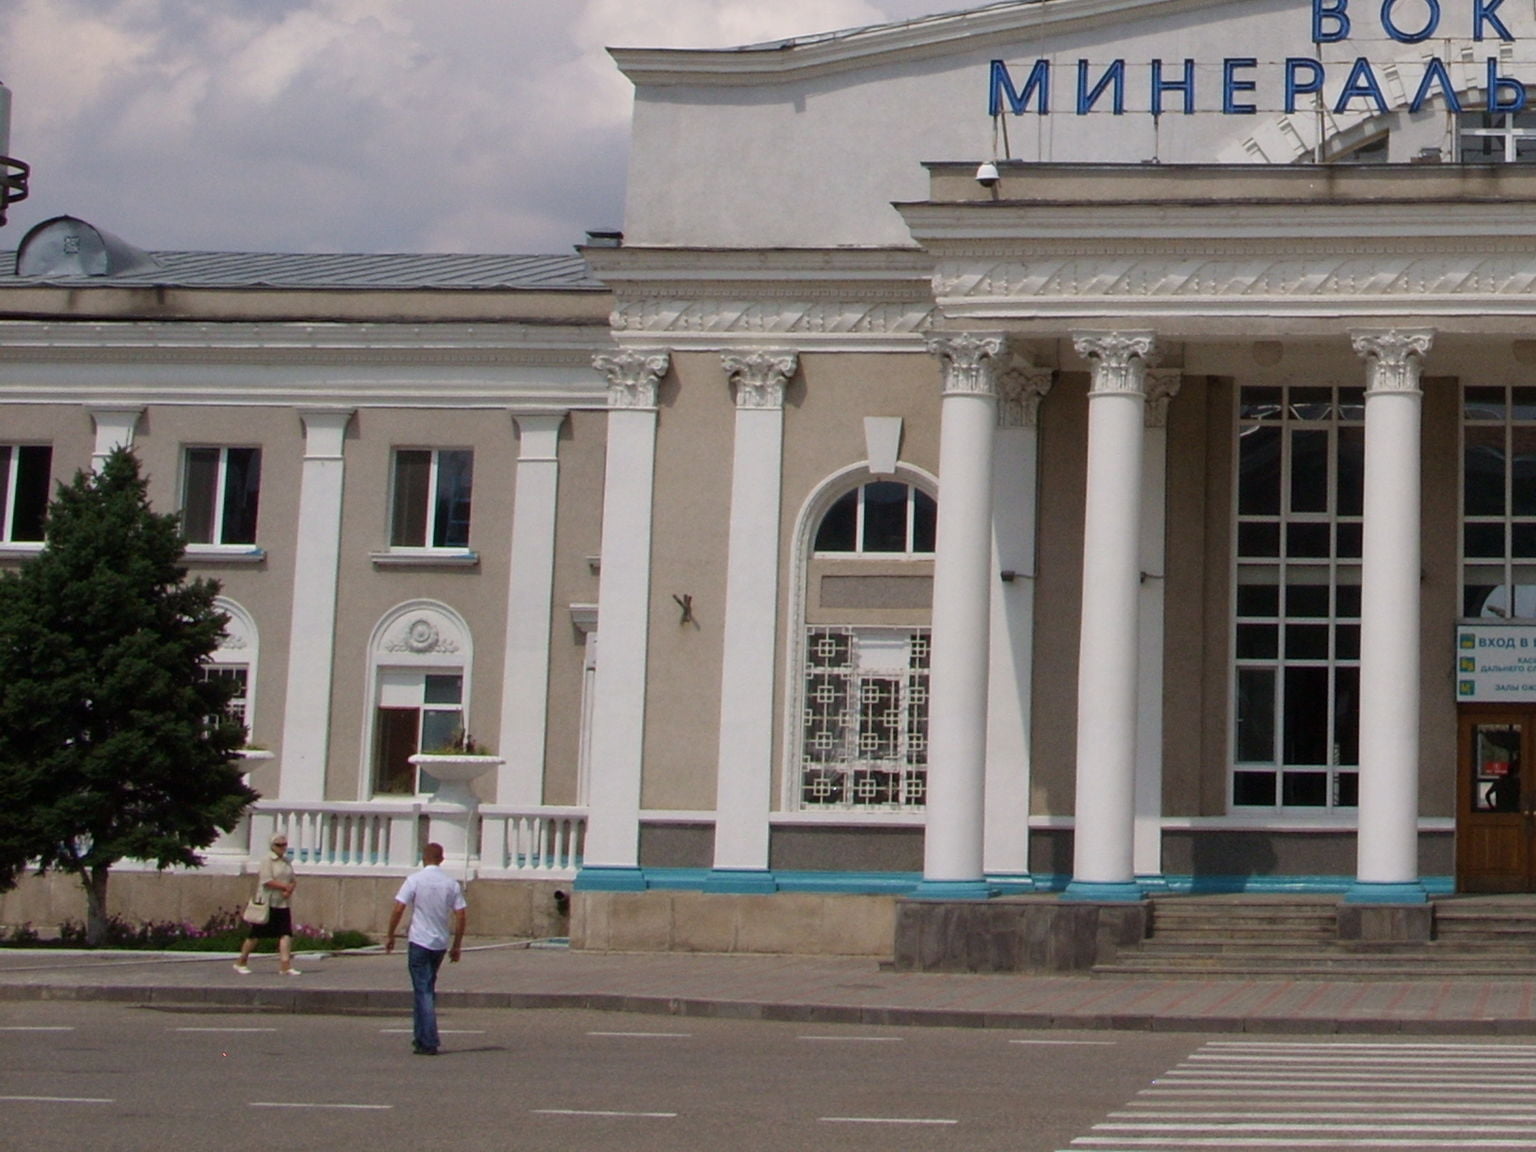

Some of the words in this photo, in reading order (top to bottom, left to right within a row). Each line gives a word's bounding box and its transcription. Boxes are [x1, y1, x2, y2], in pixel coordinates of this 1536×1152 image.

[1478, 637, 1515, 649] ВХОД
[1520, 637, 1529, 648] В
[1480, 665, 1525, 673] ДАЛЬНЕГО
